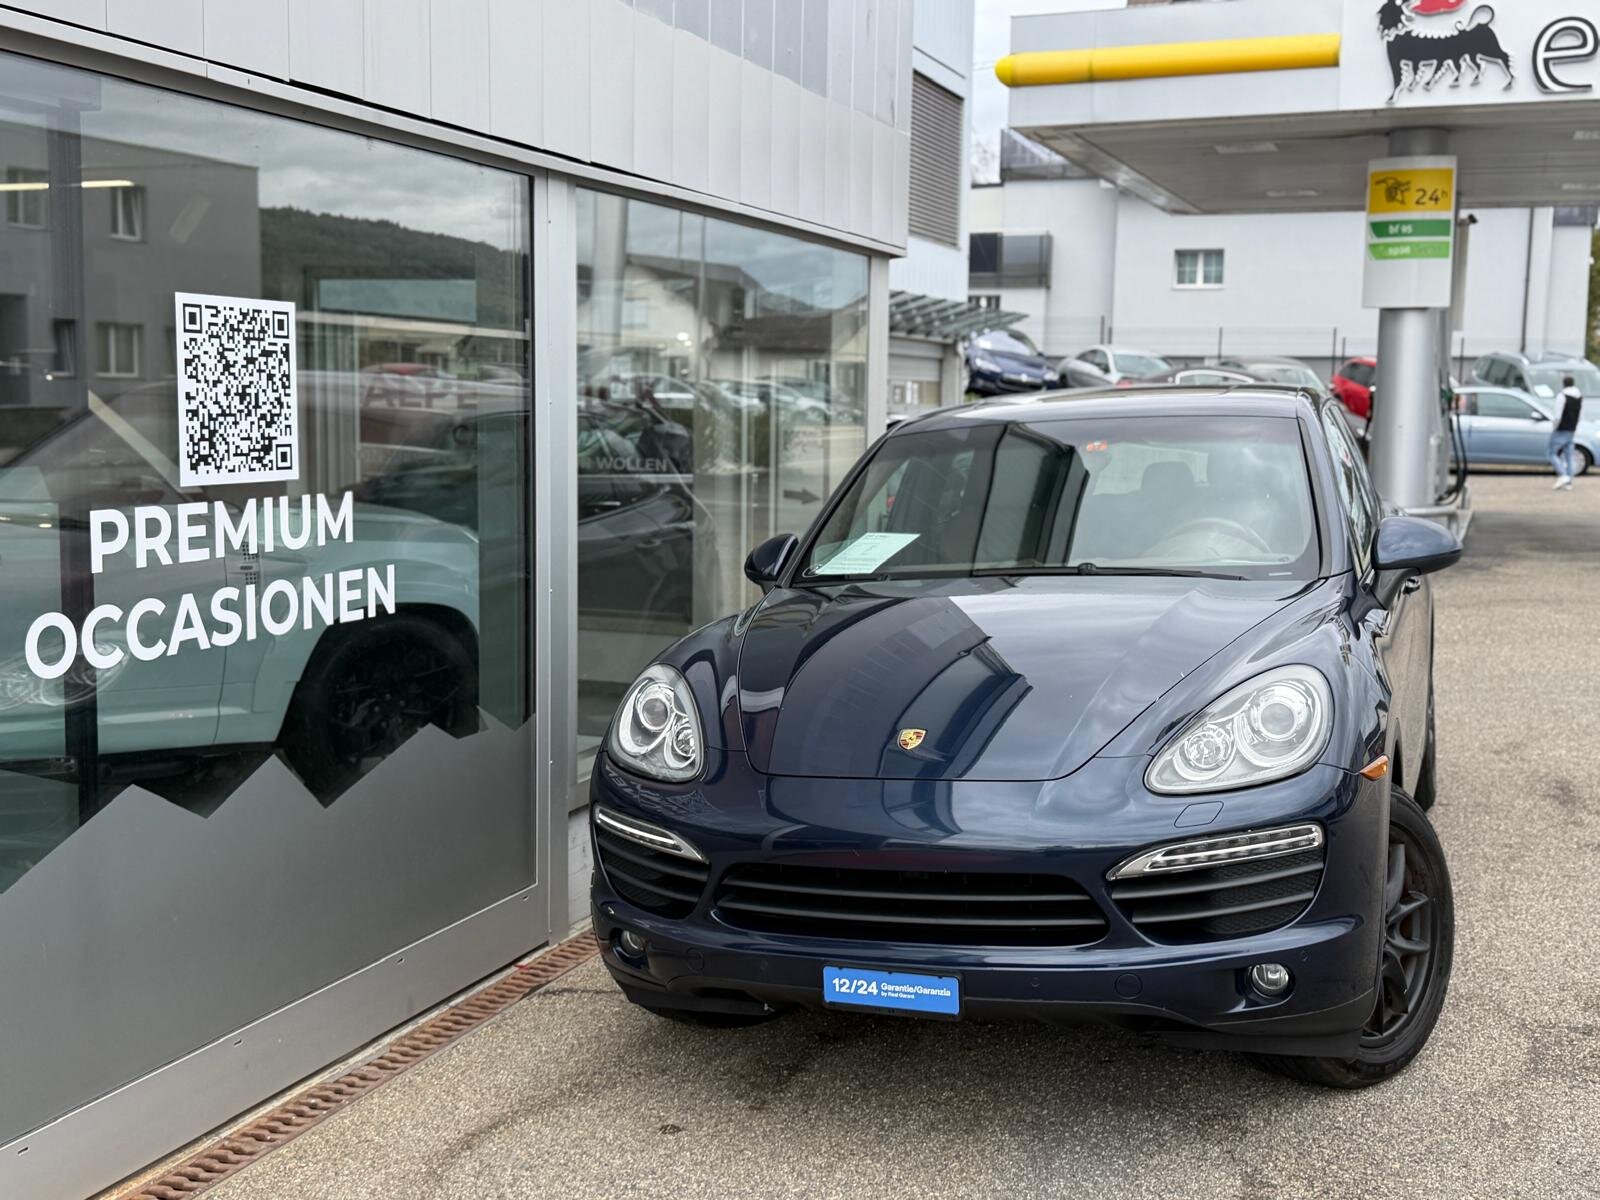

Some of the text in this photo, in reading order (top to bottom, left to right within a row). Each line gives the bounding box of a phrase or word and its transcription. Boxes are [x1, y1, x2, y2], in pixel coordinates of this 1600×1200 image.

[89, 491, 354, 574] PREMIUM
[25, 564, 396, 680] OCCASIONEN
[832, 978, 951, 997] 12/24 Garantie/Garanzia
